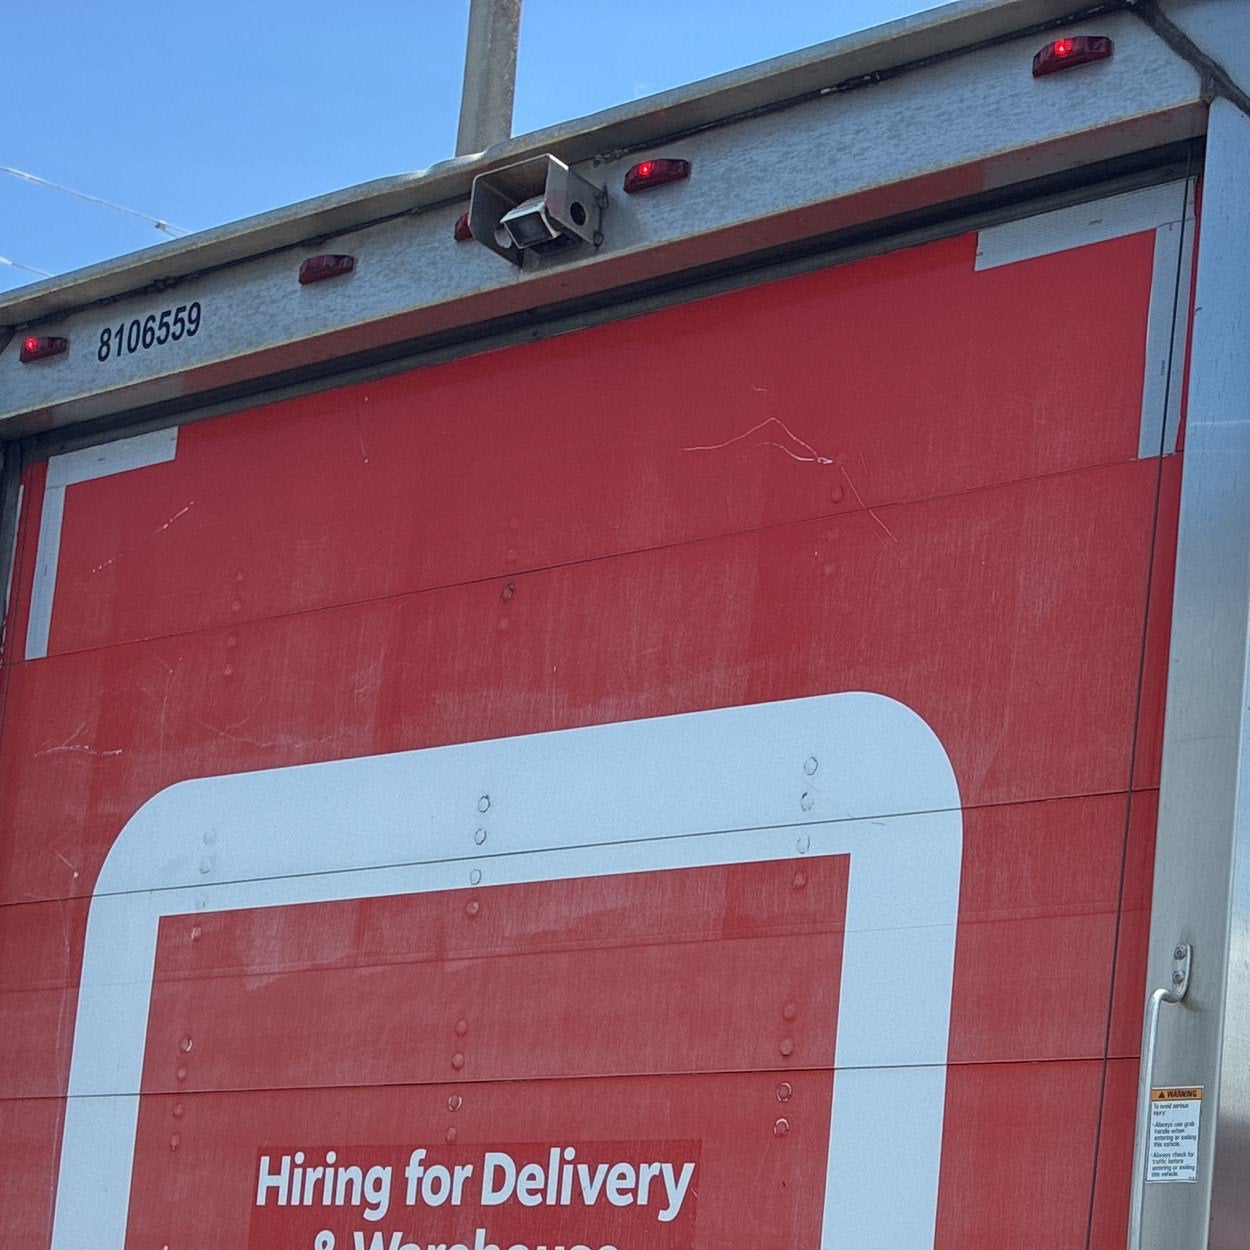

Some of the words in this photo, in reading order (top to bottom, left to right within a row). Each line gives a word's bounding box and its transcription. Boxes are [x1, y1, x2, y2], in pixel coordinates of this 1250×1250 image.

[98, 301, 201, 362] 8106559
[1167, 1089, 1198, 1098] WARNING
[256, 1150, 393, 1222] Hiring
[404, 1148, 473, 1207] for
[480, 1146, 696, 1222] Delivery
